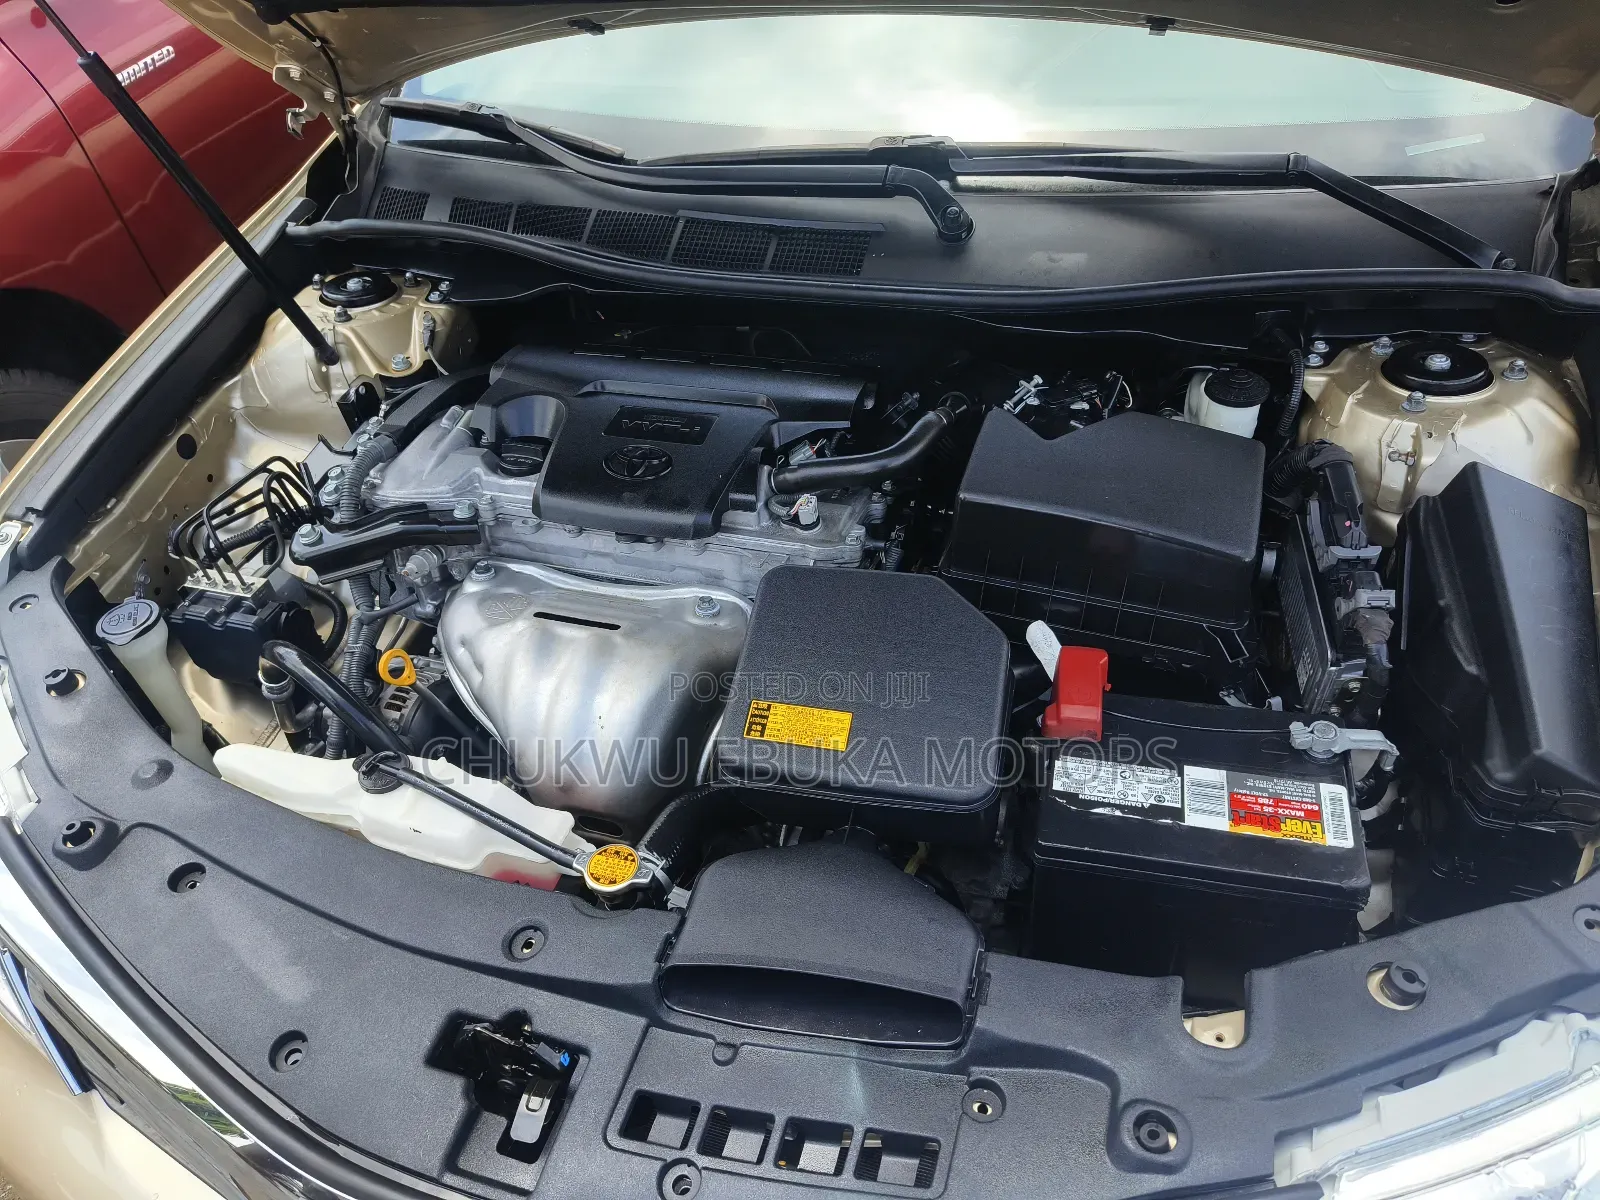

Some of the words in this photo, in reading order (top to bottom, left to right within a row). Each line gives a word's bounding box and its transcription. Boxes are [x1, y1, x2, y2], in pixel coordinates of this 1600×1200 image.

[115, 45, 176, 87] IMITED
[1262, 805, 1306, 818] MAXX-35
[1300, 803, 1320, 811] 640
[1231, 809, 1324, 840] EverStart
